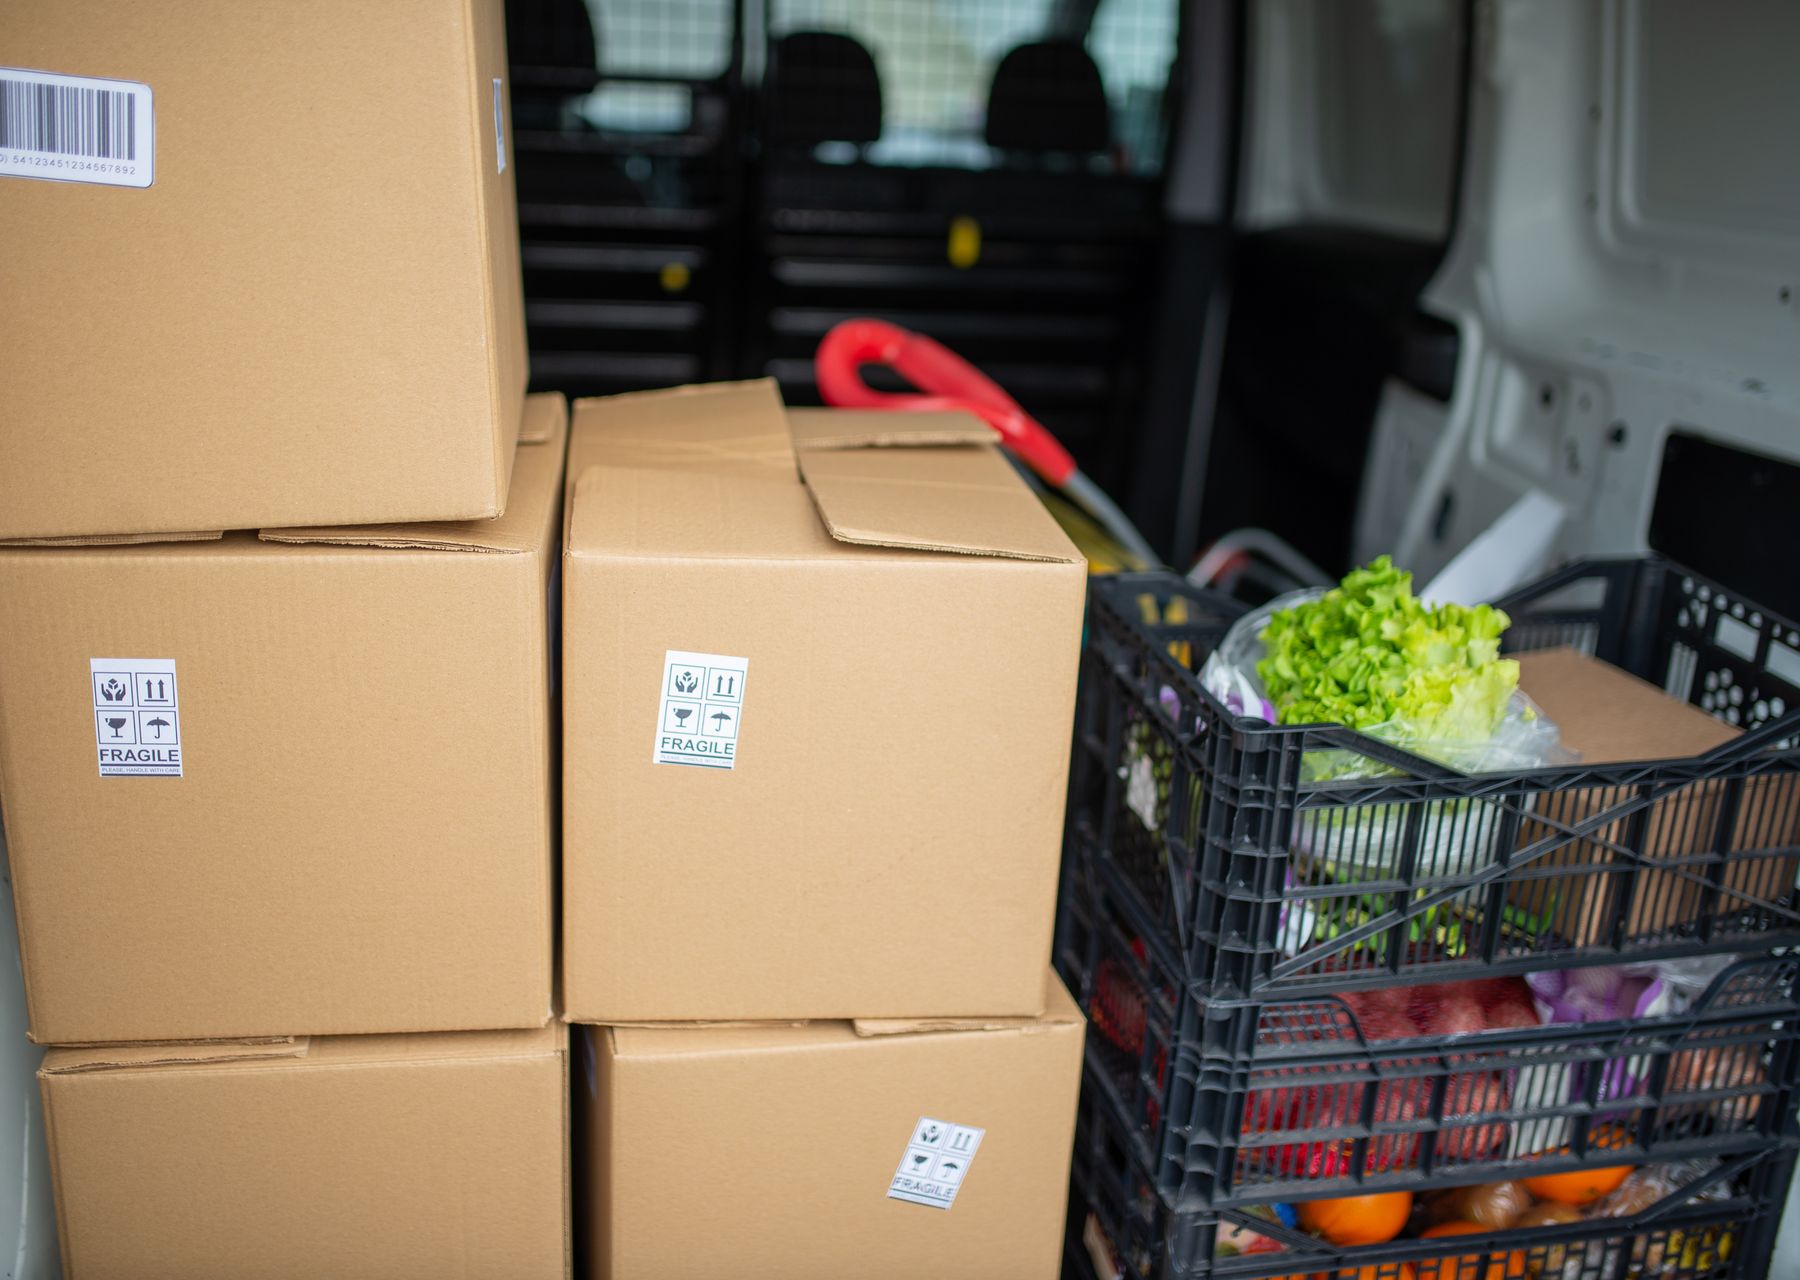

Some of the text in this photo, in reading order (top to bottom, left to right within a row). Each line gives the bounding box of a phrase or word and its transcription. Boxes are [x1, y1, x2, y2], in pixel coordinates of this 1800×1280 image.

[12, 155, 136, 175] 54123451234567892
[100, 749, 179, 762] FRAGILE
[661, 737, 734, 755] FRAGILE
[891, 1176, 954, 1198] FRAGILE
